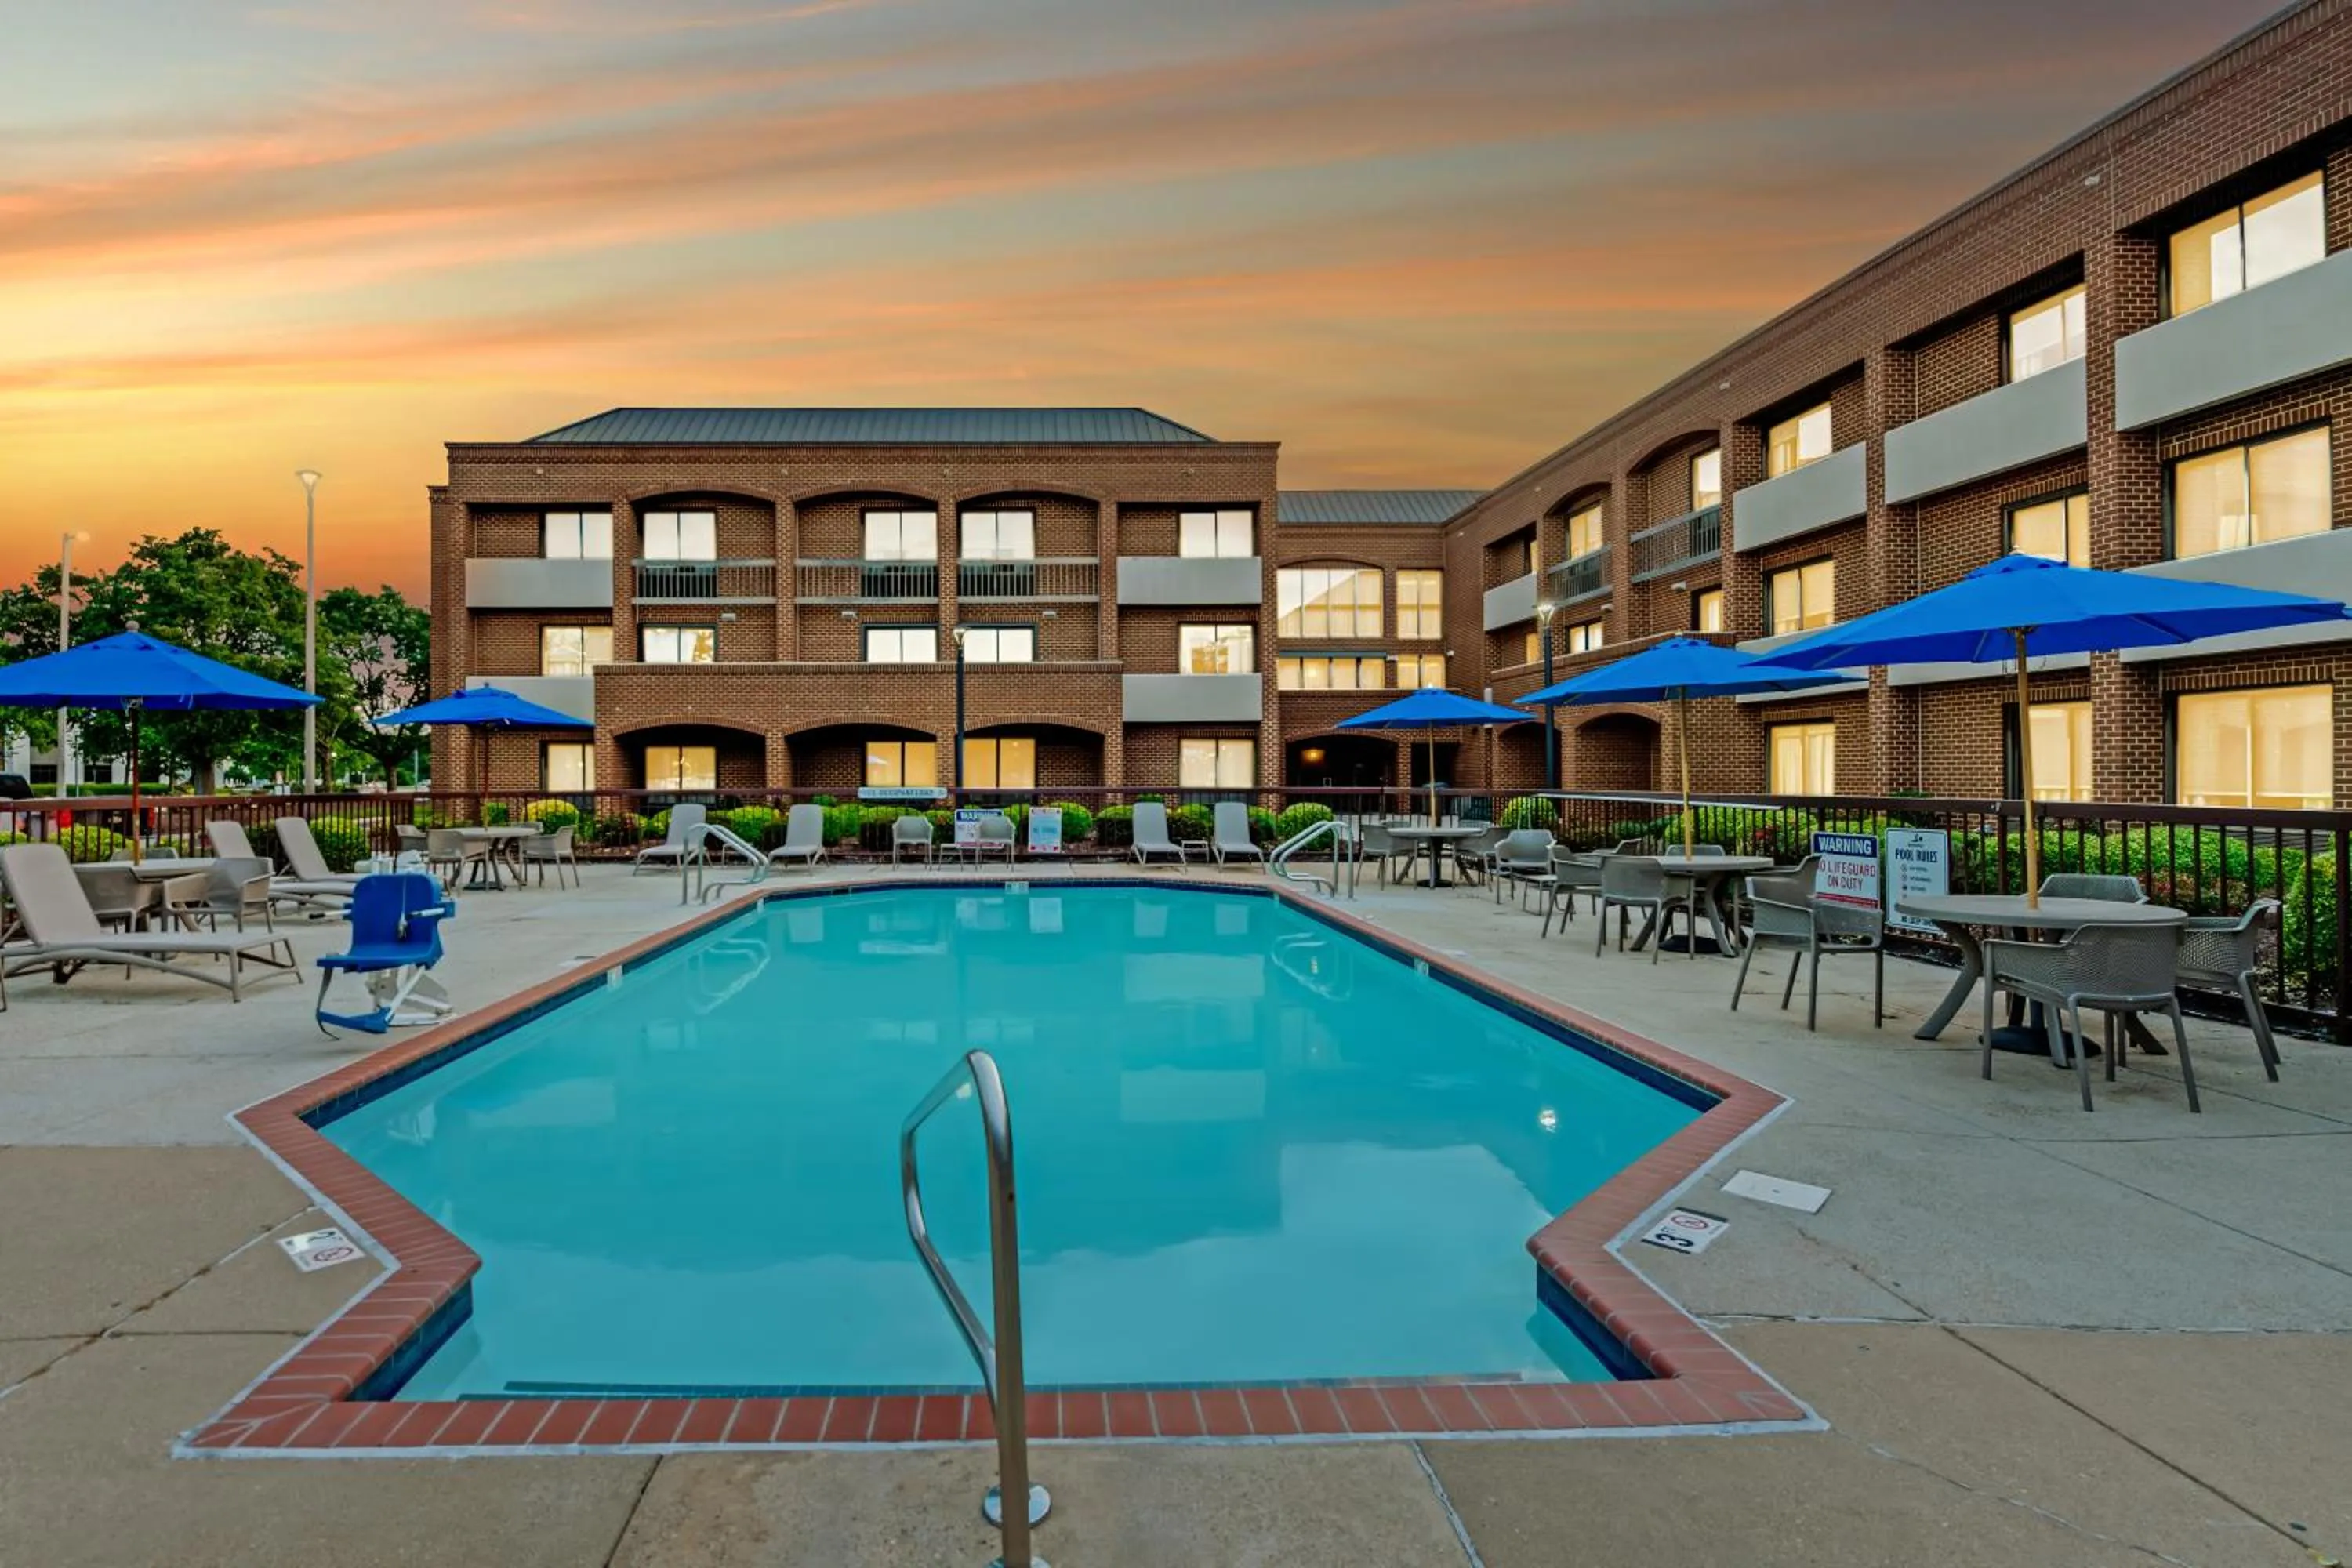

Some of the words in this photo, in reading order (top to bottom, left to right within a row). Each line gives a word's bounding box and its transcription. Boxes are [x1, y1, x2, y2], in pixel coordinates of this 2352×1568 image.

[1818, 836, 1872, 855] WARNING
[1895, 848, 1914, 862] POOL
[1916, 849, 1938, 863] RULES
[1828, 860, 1876, 877] LIFEGUARD
[1828, 874, 1838, 887] ON
[1840, 877, 1864, 891] DUTY
[1655, 1233, 1694, 1247] 3
